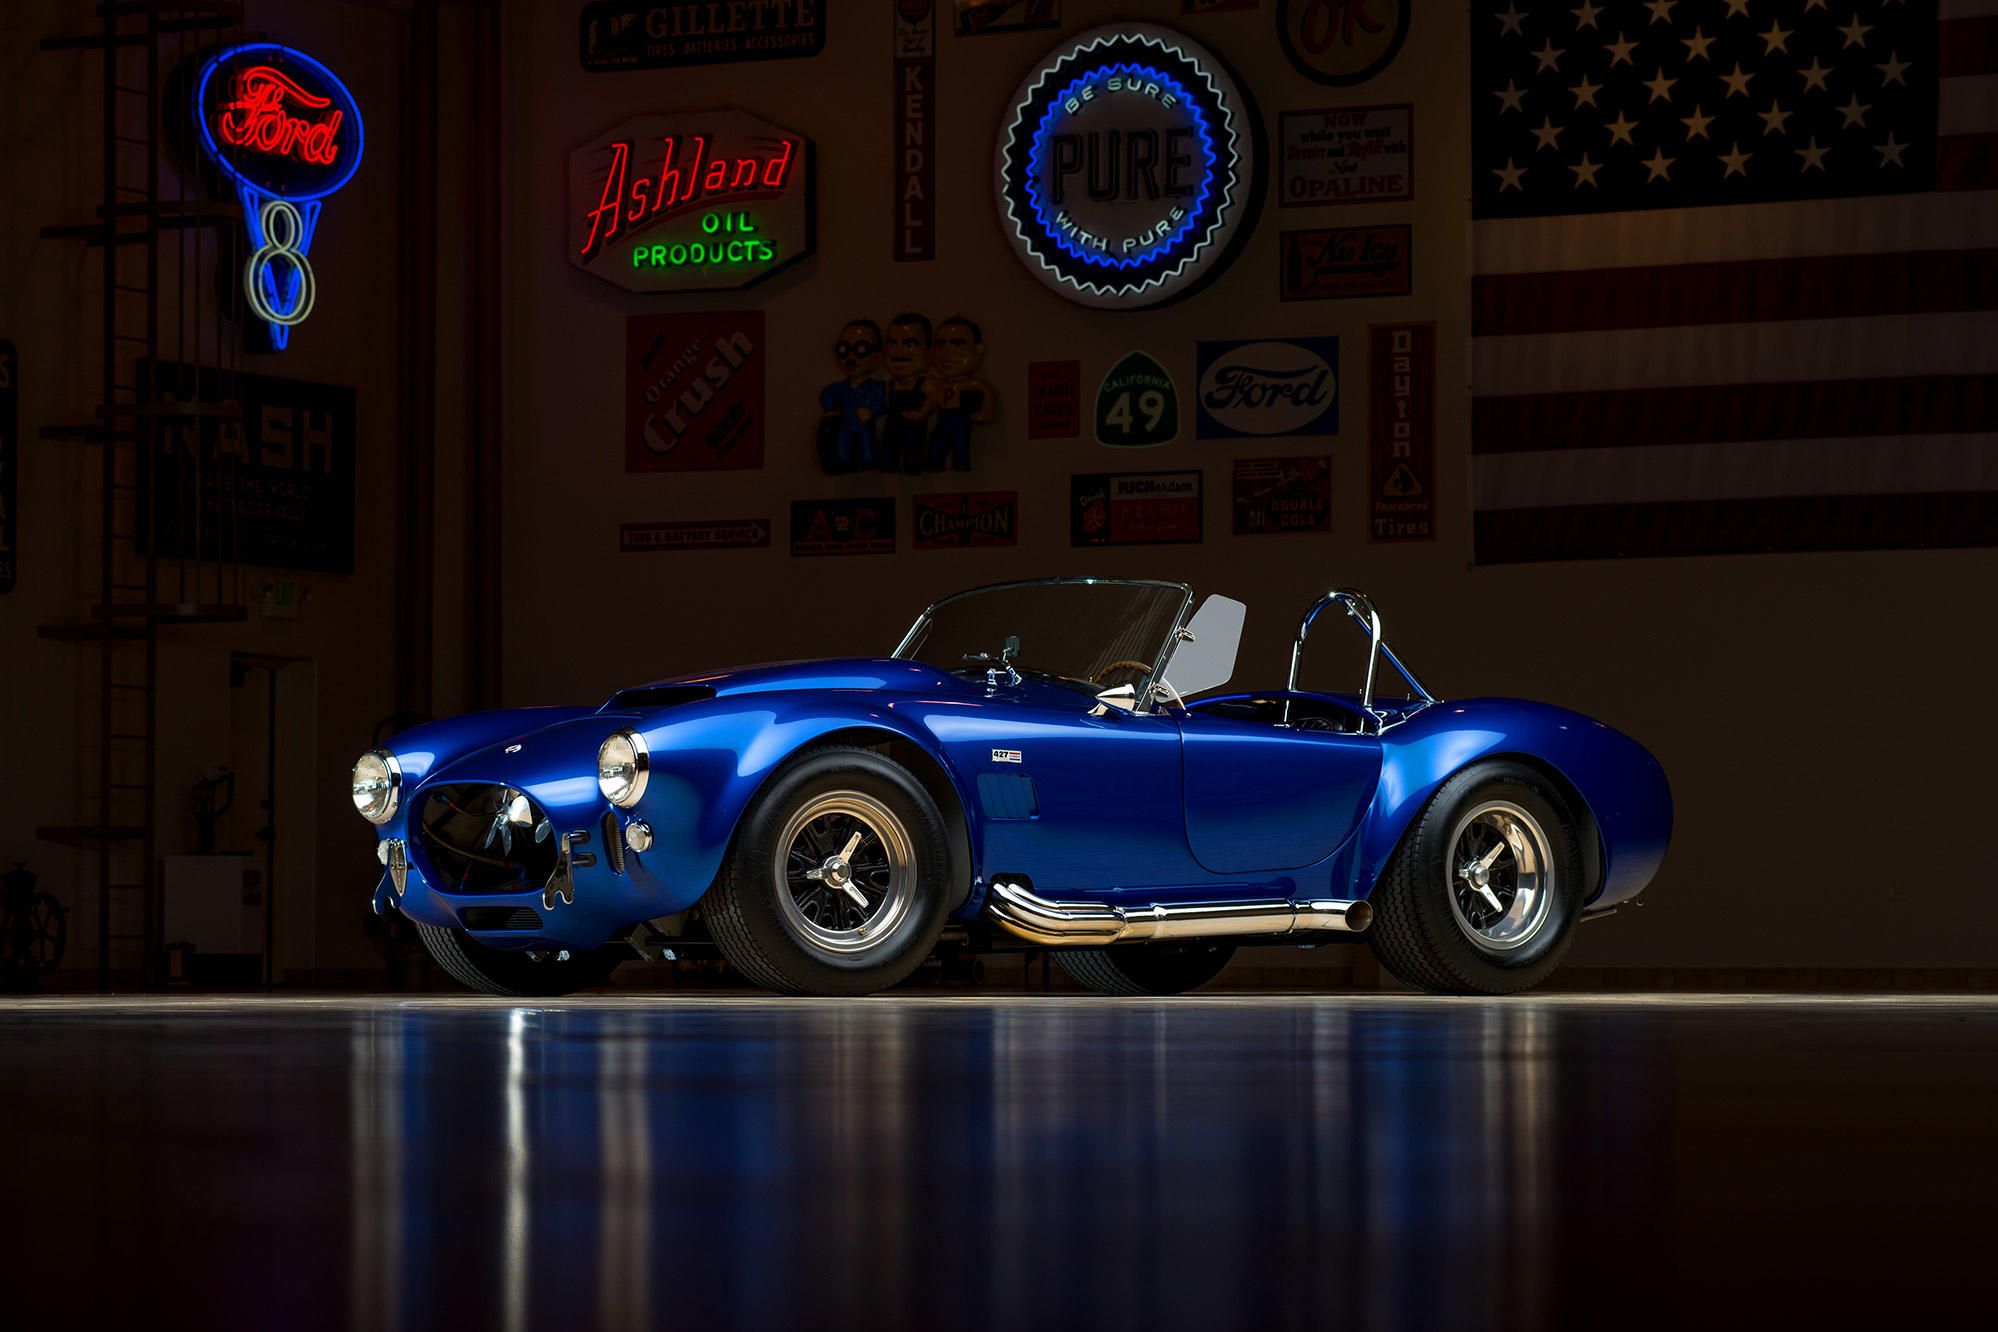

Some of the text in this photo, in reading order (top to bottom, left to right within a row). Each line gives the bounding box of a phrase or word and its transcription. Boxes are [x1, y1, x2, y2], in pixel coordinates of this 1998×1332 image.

[646, 0, 816, 39] GILLETTE
[646, 32, 816, 57] TIRES BATTERIES ACCESSORIES
[1064, 78, 1178, 115] BE SURE
[214, 65, 343, 166] Ford
[1324, 112, 1368, 128] NOW
[1300, 126, 1391, 144] while you wait
[1384, 139, 1407, 154] with
[904, 65, 925, 254] KENDALL
[1053, 127, 1194, 205] PURE
[580, 134, 797, 264] Ashland
[1289, 174, 1404, 198] OPALINE
[702, 211, 757, 235] OIL
[1056, 205, 1187, 253] WITH PURE
[632, 239, 776, 268] PRODUCTS
[645, 335, 706, 405] Orange
[1104, 373, 1171, 392] CALIFORNIA
[641, 330, 756, 456] Crush
[1203, 364, 1330, 409] Ford
[1391, 328, 1413, 458] Dayton
[1104, 389, 1167, 434] 49
[919, 504, 1009, 537] CHAMPION
[1271, 498, 1325, 512] DOUBLE
[1280, 513, 1315, 527] COLA
[714, 528, 758, 541] SERVICE
[1374, 516, 1430, 536] Tires
[993, 750, 1009, 758] 427
